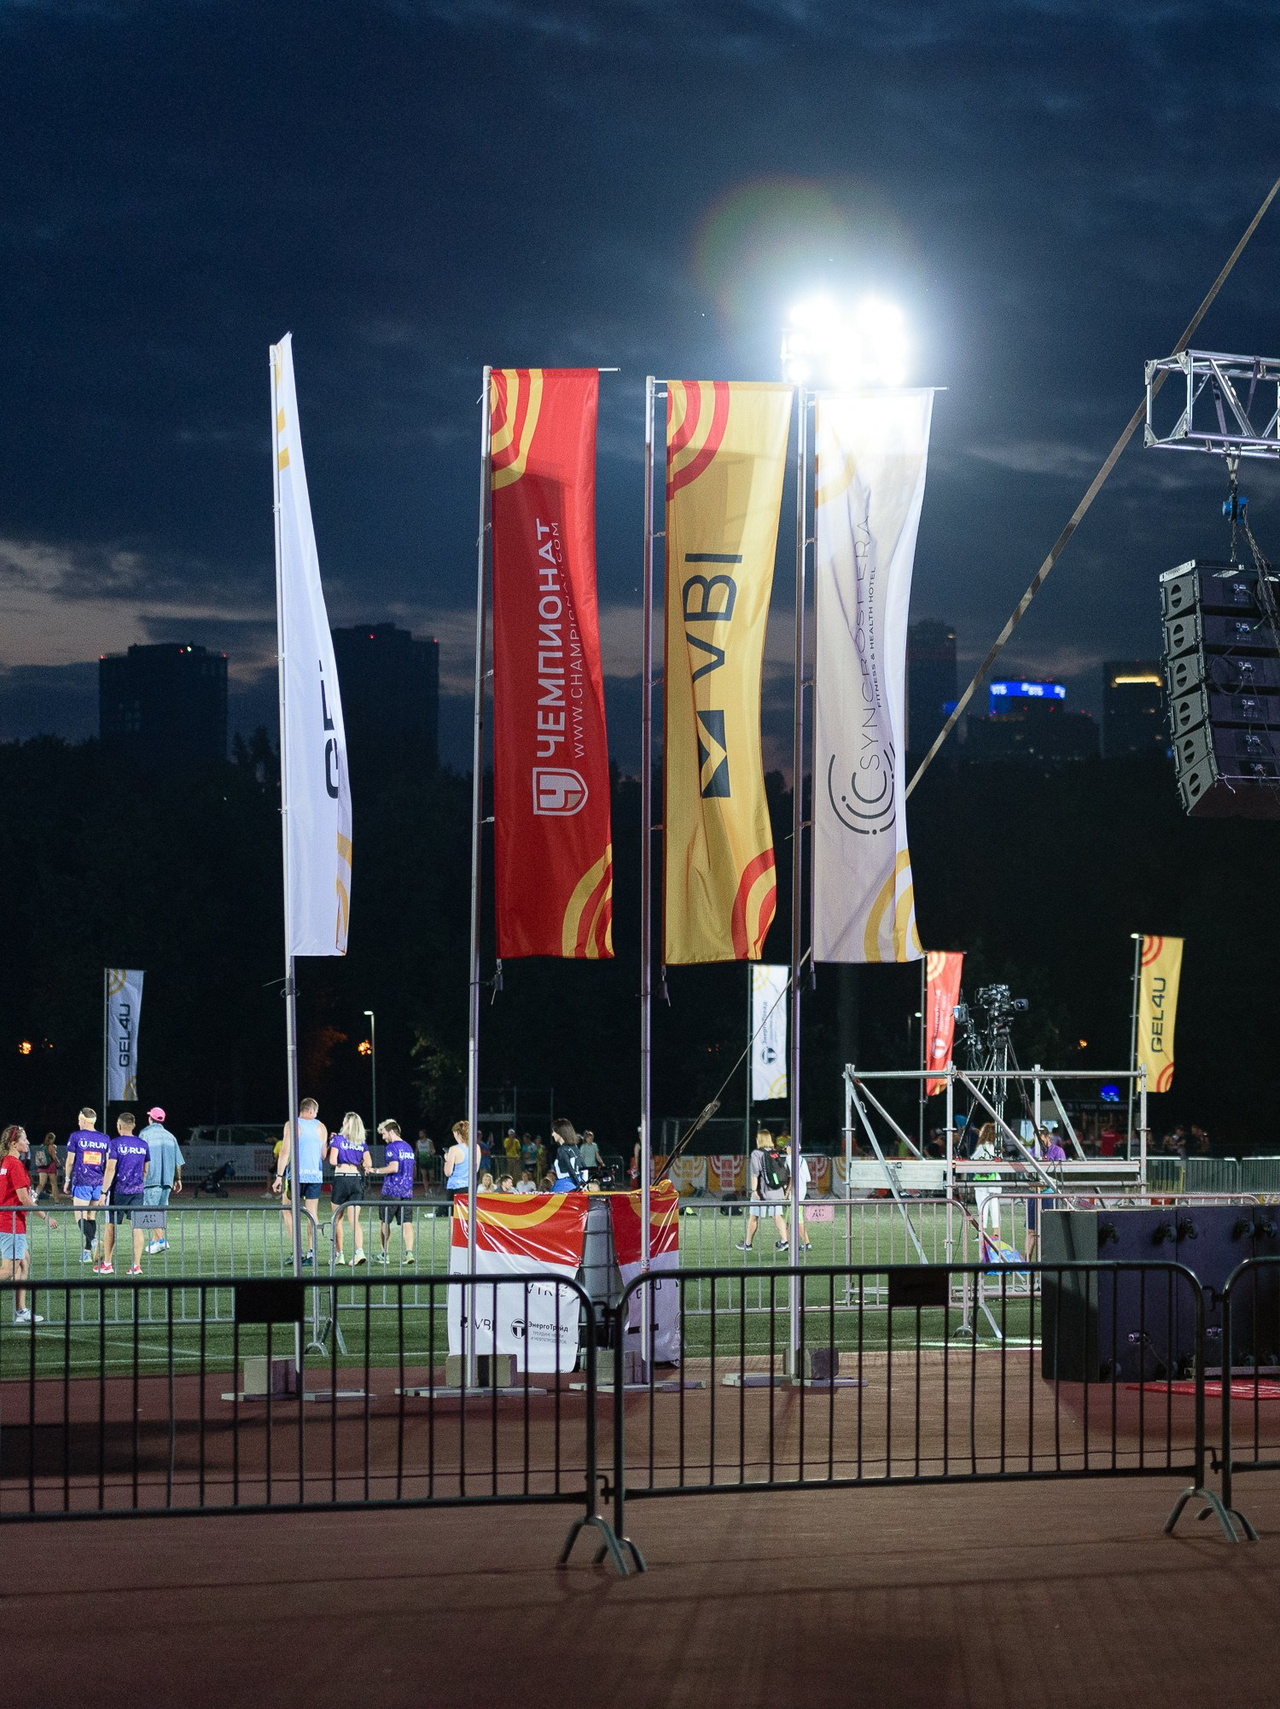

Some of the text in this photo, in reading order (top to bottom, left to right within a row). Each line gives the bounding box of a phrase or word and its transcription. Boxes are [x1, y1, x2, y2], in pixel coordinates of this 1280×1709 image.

[868, 566, 877, 600] HOTEL
[535, 517, 567, 758] ЧЕМПИОНАТ
[551, 522, 585, 758] WWW.CHAMPIONAT.COM
[682, 553, 743, 684] VBI
[871, 663, 882, 708] FITNESS
[119, 1003, 130, 1067] GEL4U
[1151, 977, 1166, 1053] GEL4U
[528, 1321, 568, 1333] ЭнергоТрйд
